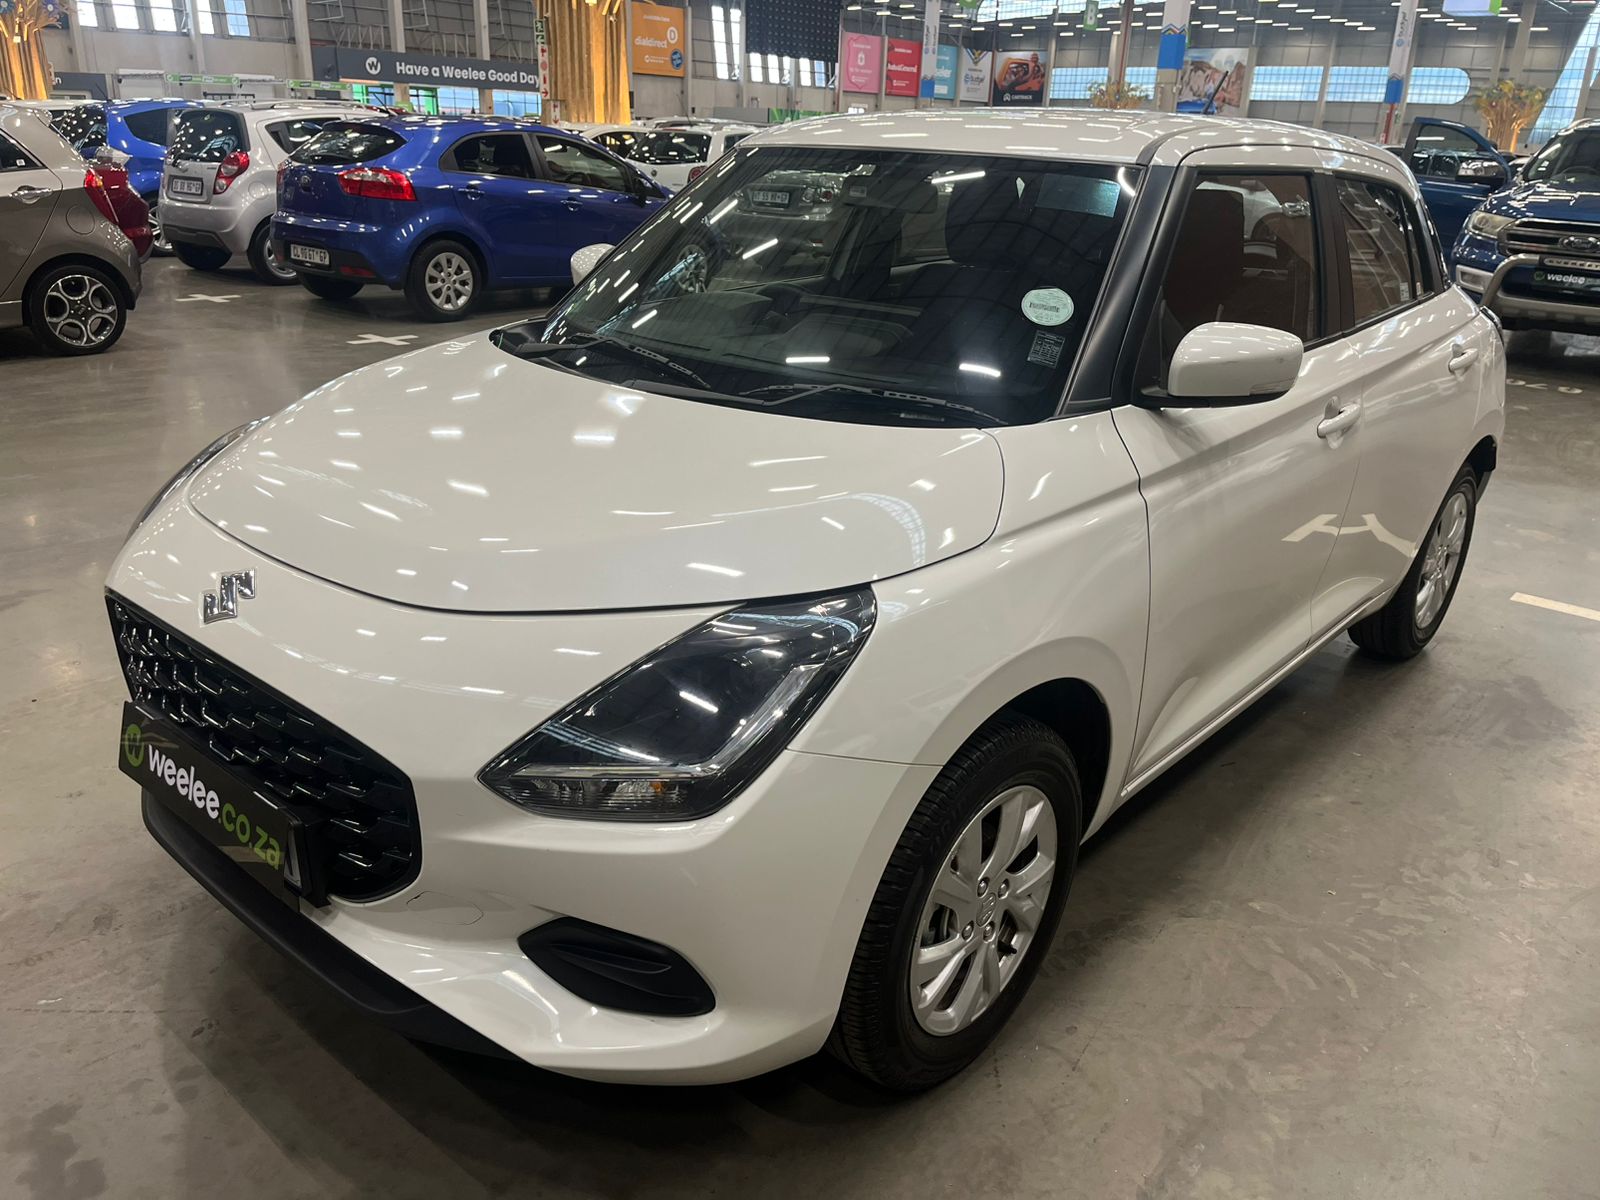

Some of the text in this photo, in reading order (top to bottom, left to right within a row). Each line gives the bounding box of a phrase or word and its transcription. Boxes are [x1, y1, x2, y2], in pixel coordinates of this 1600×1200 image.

[396, 61, 430, 76] Have
[431, 66, 440, 77] a
[441, 66, 486, 81] Weelee
[488, 69, 518, 83] Good
[520, 72, 540, 87] Day
[148, 744, 281, 870] weelee.co.za
